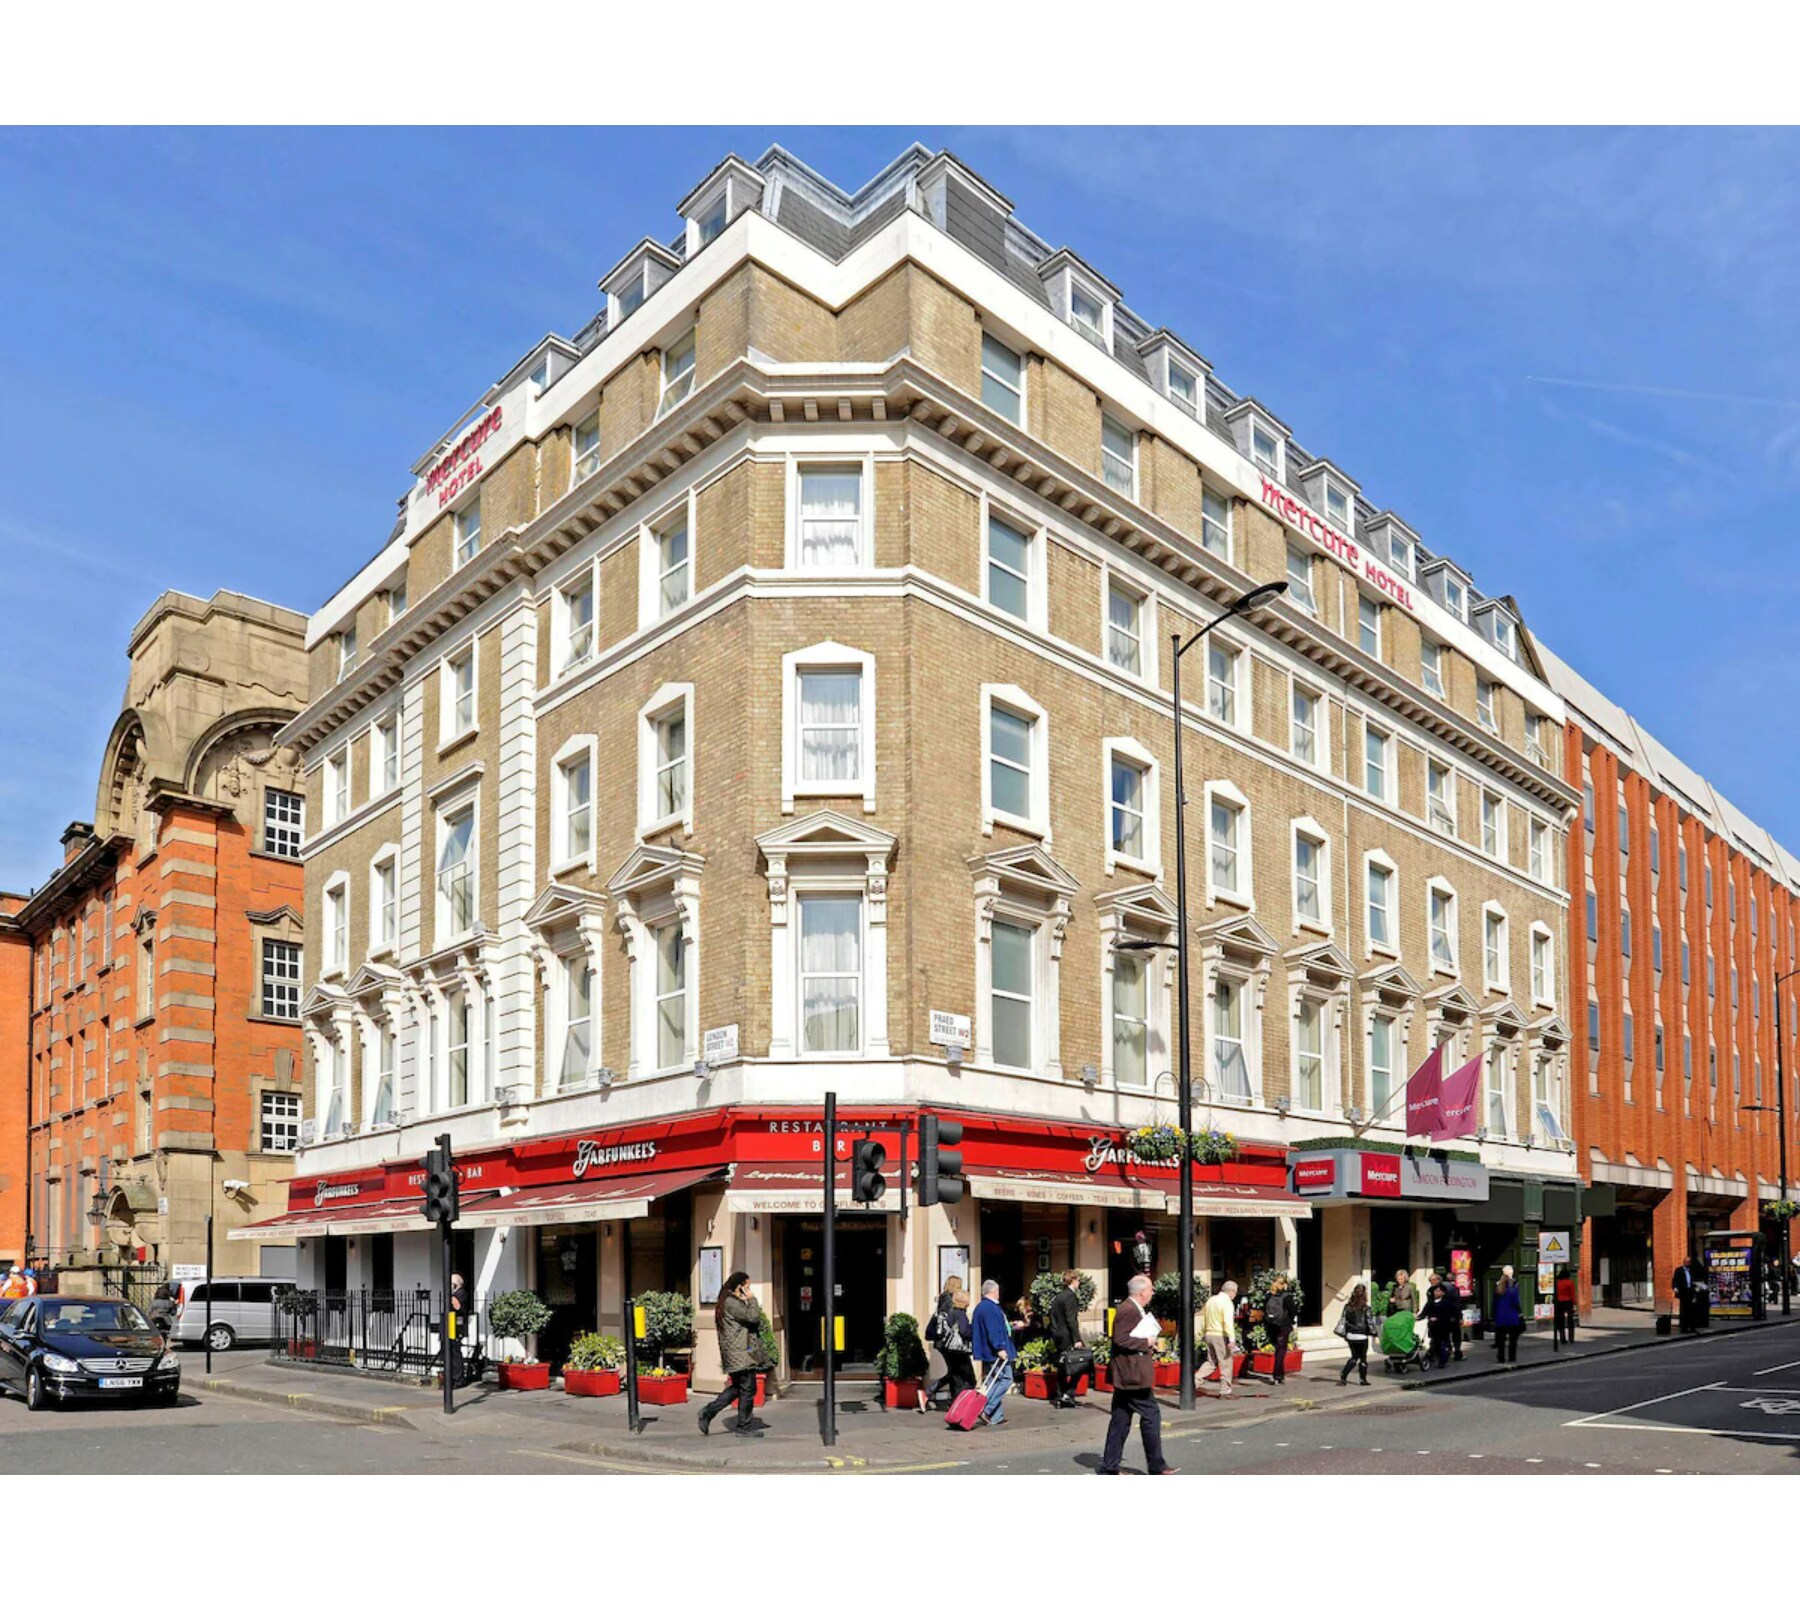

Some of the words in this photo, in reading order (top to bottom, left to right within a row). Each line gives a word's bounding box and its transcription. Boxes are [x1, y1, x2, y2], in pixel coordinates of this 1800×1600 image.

[439, 456, 484, 509] HOTEL
[1365, 560, 1414, 611] HOTEL
[934, 1013, 955, 1025] PRAED
[934, 1024, 957, 1035] STREET
[706, 1030, 727, 1042] LONDON
[706, 1040, 724, 1052] STREET
[769, 1121, 888, 1133] RESTARANT
[812, 1140, 846, 1152] BR
[467, 1166, 483, 1179] BAR
[1298, 1167, 1328, 1178] Mercure
[1367, 1169, 1398, 1183] Mercure
[1027, 1190, 1046, 1199] WINES
[1056, 1192, 1084, 1202] COFFEES
[753, 1201, 801, 1209] WELCOME
[805, 1201, 817, 1209] TO
